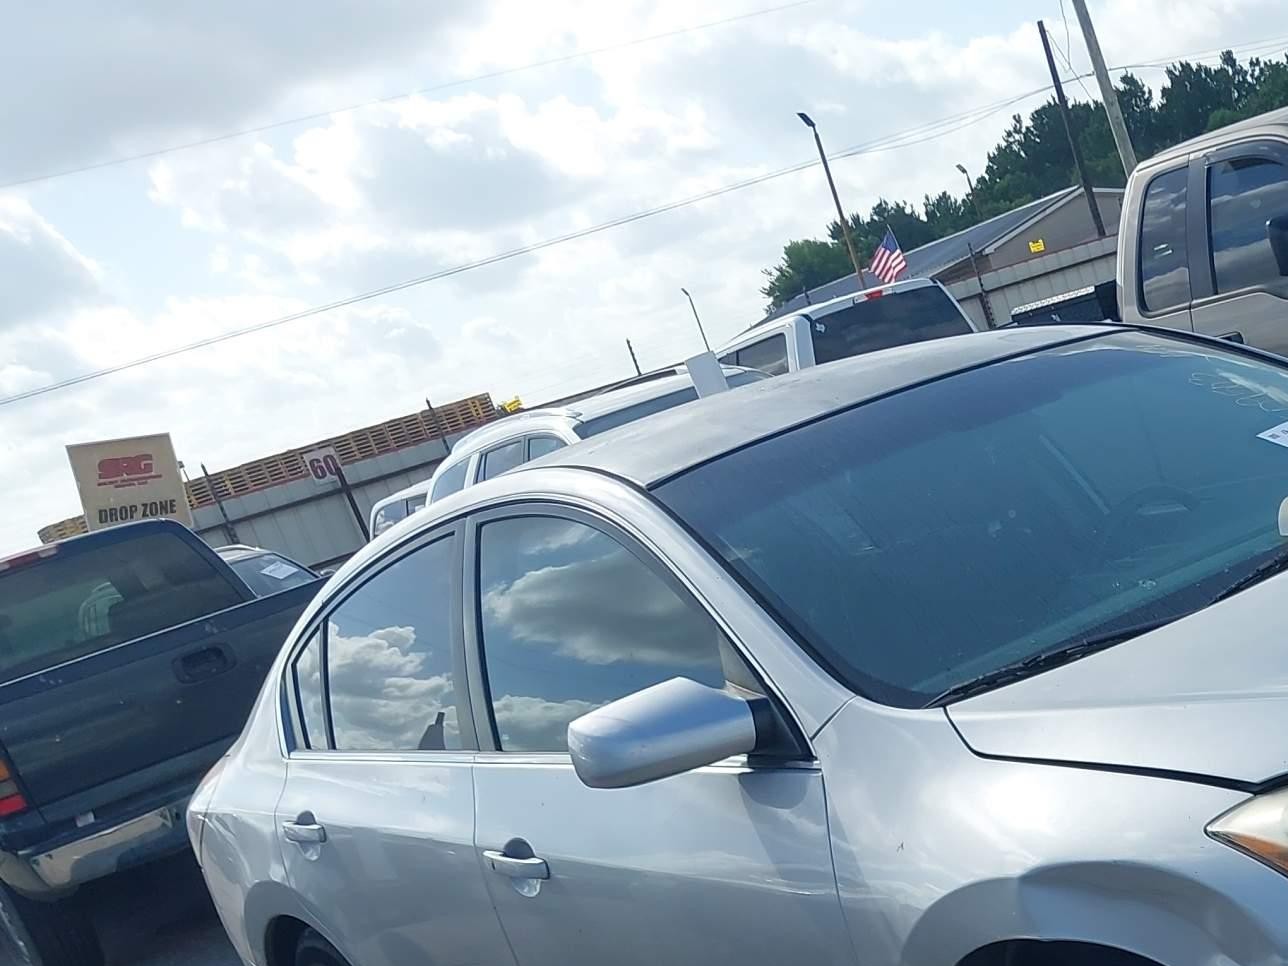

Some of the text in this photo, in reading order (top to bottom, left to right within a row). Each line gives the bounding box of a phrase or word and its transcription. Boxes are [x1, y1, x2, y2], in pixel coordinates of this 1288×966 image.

[310, 455, 338, 480] 60
[98, 499, 177, 523] DROP ZONE
